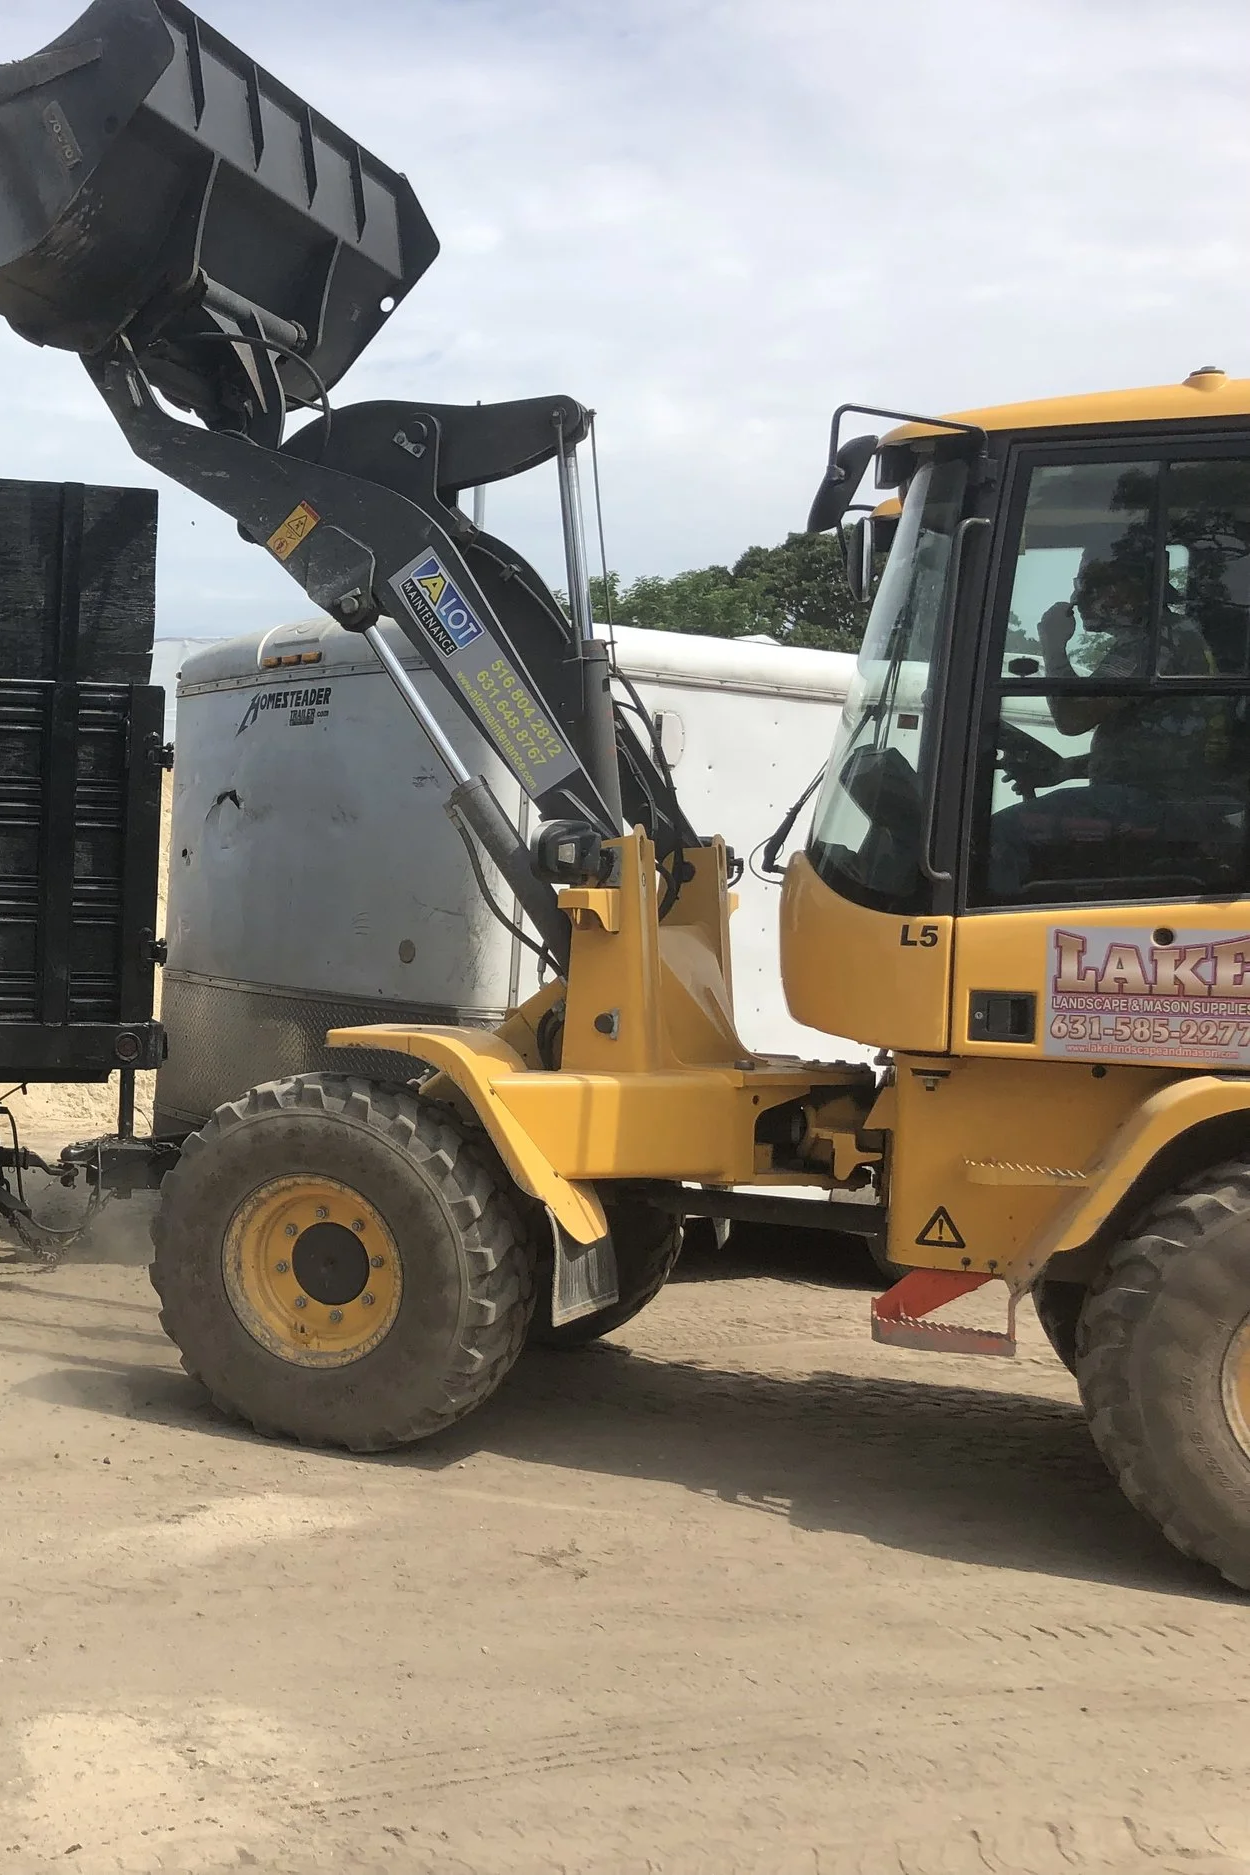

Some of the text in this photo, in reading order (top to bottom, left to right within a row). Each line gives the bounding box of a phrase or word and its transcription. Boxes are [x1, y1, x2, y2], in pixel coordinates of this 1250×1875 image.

[403, 580, 456, 654] MAINTENANCE
[236, 687, 332, 736] HOMESTEADER
[456, 670, 537, 790] www.alotmaintenance.com
[476, 670, 548, 766] 631.648.8767
[491, 659, 562, 758] 516.804.2812
[900, 924, 938, 947] L5
[1053, 929, 1250, 998] LAKE
[1050, 1014, 1250, 1047] 631-585-2277
[1052, 997, 1128, 1012] LANDSCAPE
[1130, 998, 1141, 1012] &
[1143, 999, 1190, 1014] MASON
[1066, 1043, 1239, 1059] www.lakelandscapeandmason.com
